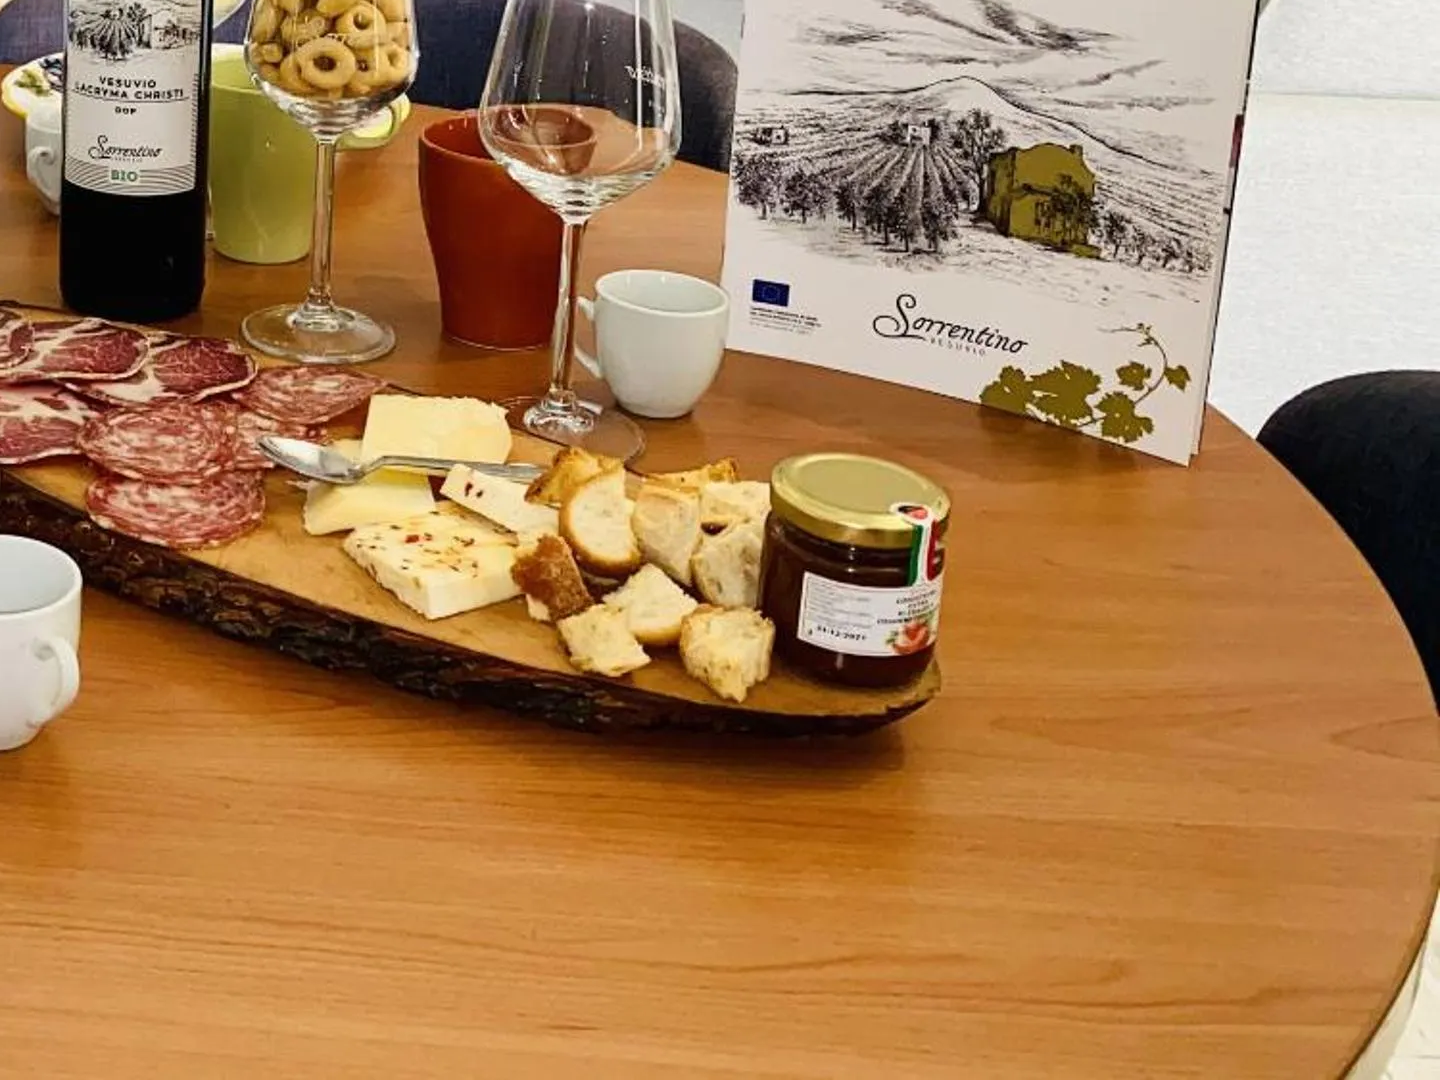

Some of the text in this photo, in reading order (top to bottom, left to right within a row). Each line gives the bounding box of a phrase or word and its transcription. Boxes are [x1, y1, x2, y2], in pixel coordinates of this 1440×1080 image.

[75, 81, 184, 100] LACRYMA CHRISTI
[99, 76, 157, 88] VESUVIO
[88, 135, 163, 160] Sorrentino
[111, 170, 138, 182] BIO
[873, 293, 1028, 354] Sorrentino
